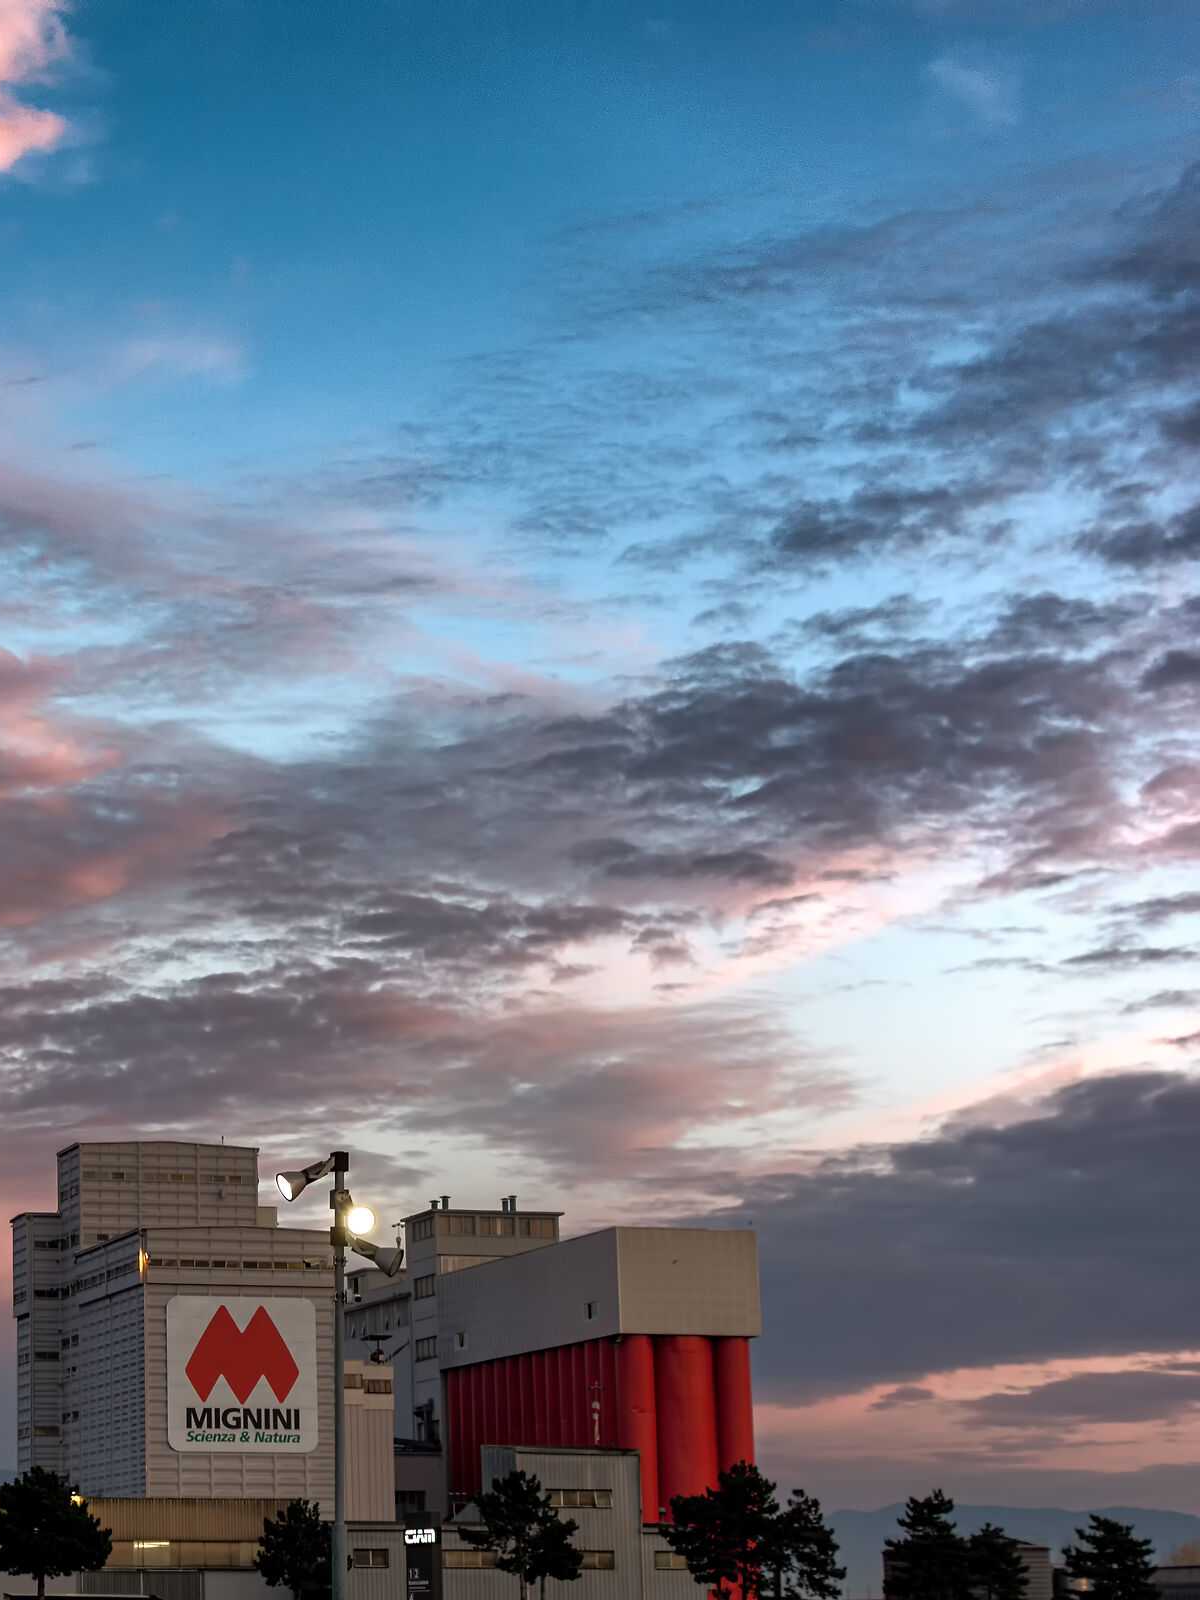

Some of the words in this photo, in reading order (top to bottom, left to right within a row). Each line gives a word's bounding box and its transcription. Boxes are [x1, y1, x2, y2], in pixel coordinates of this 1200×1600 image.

[186, 1407, 300, 1430] MIGNINI
[186, 1430, 236, 1442] Scienza
[239, 1431, 250, 1443] &
[254, 1431, 300, 1443] Natura
